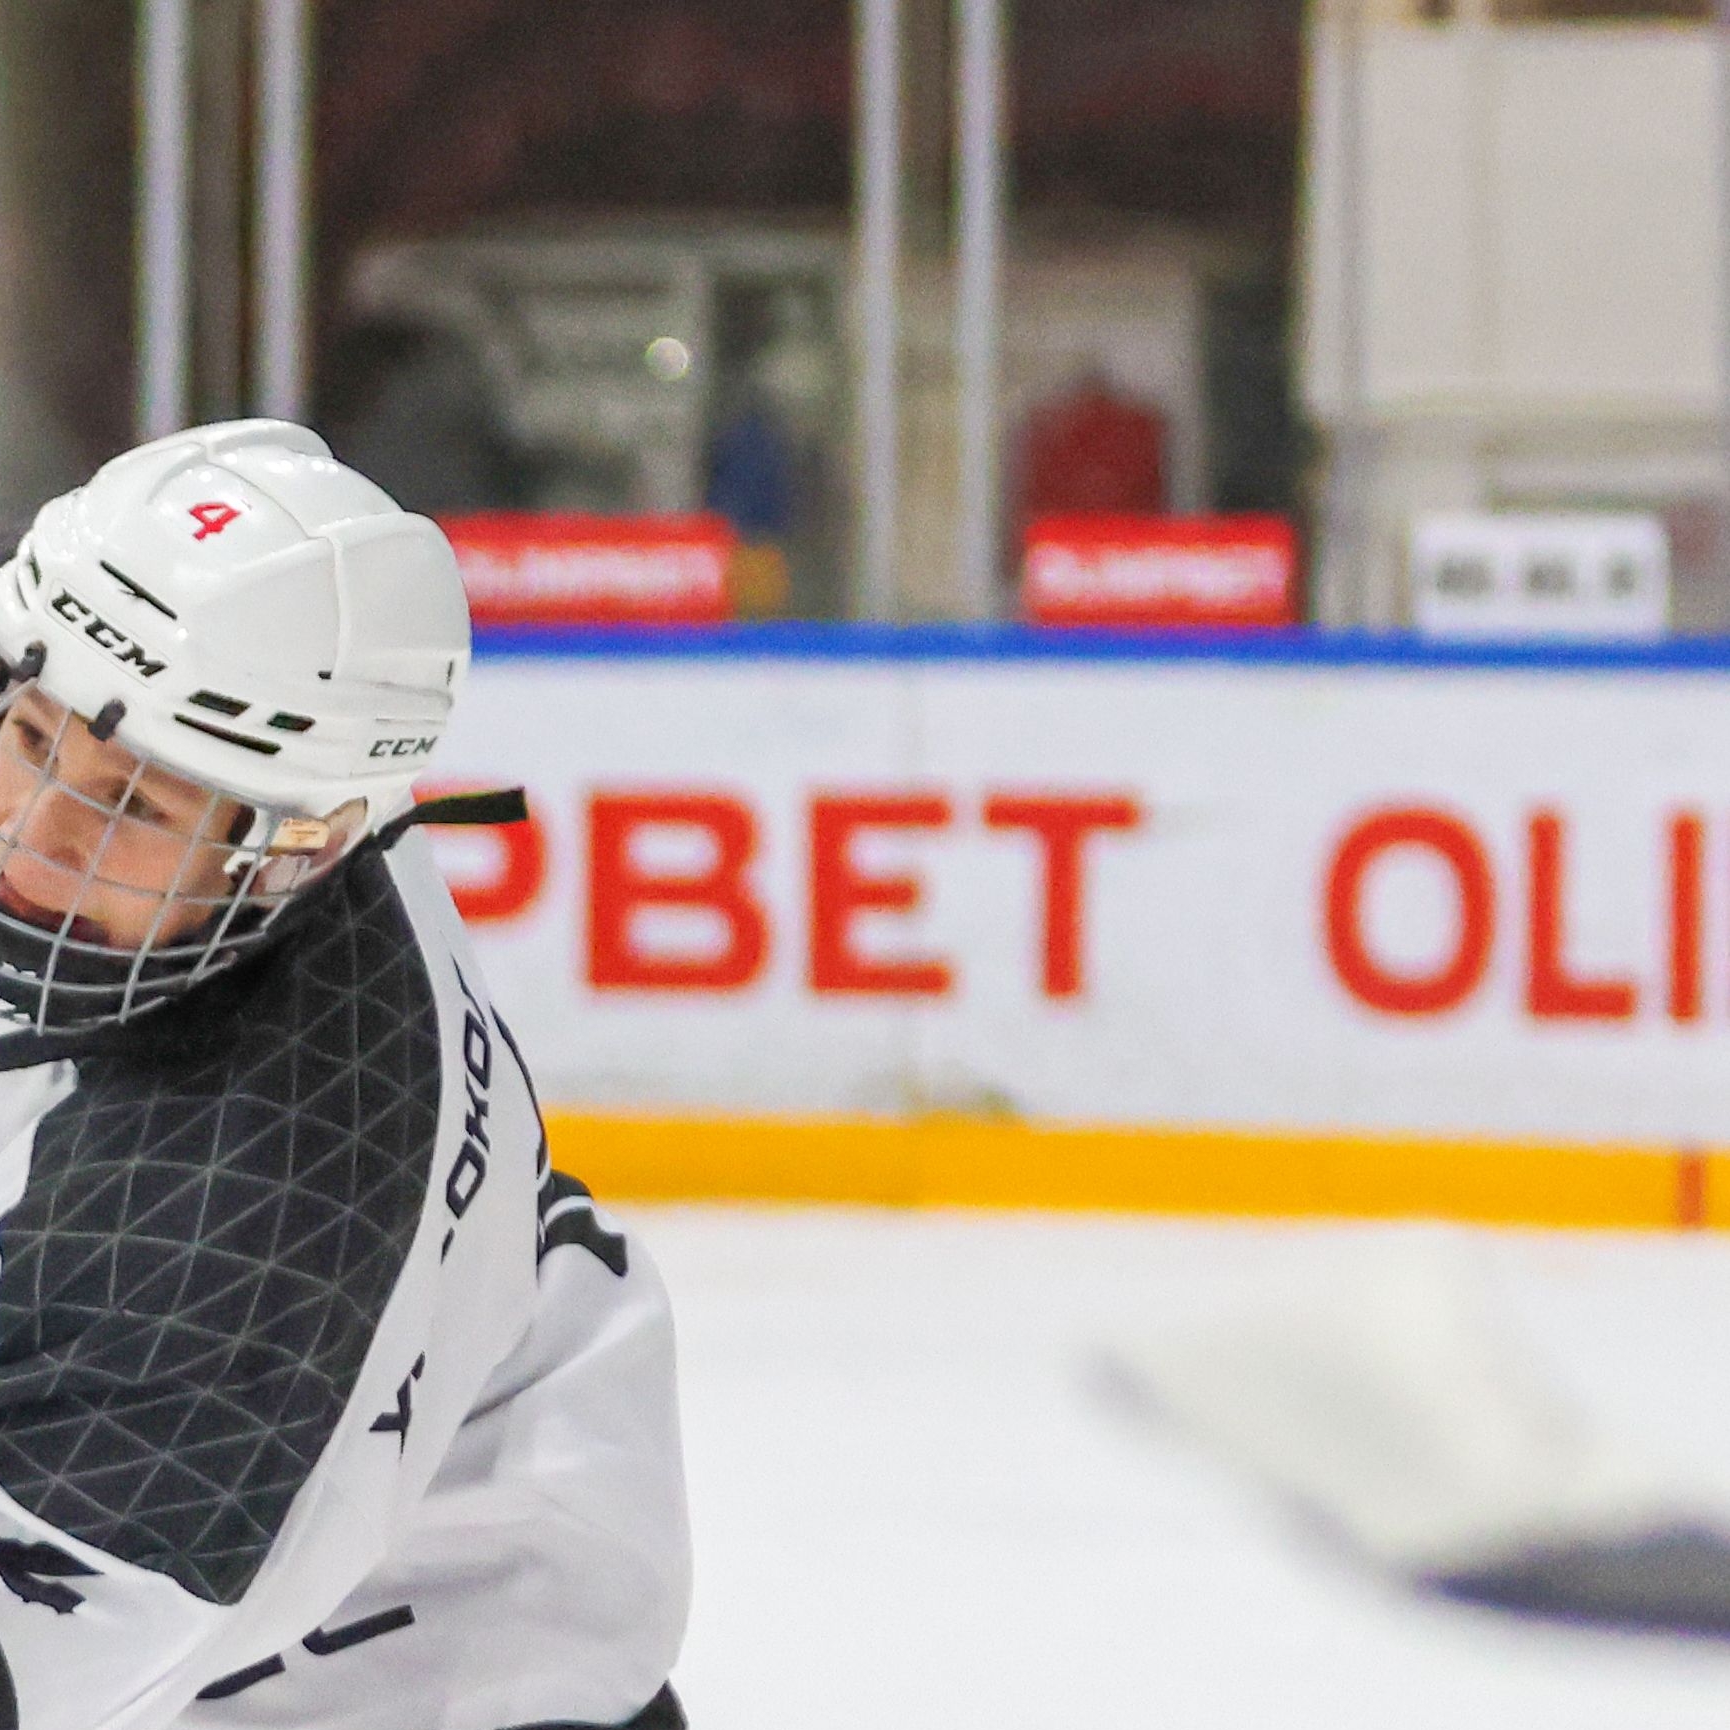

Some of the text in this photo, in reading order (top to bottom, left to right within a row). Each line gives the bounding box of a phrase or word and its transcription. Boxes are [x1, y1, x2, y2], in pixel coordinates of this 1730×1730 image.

[190, 501, 241, 541] 4
[51, 588, 168, 678] CCM
[368, 735, 438, 757] CCM
[1324, 810, 1730, 1021] OLI
